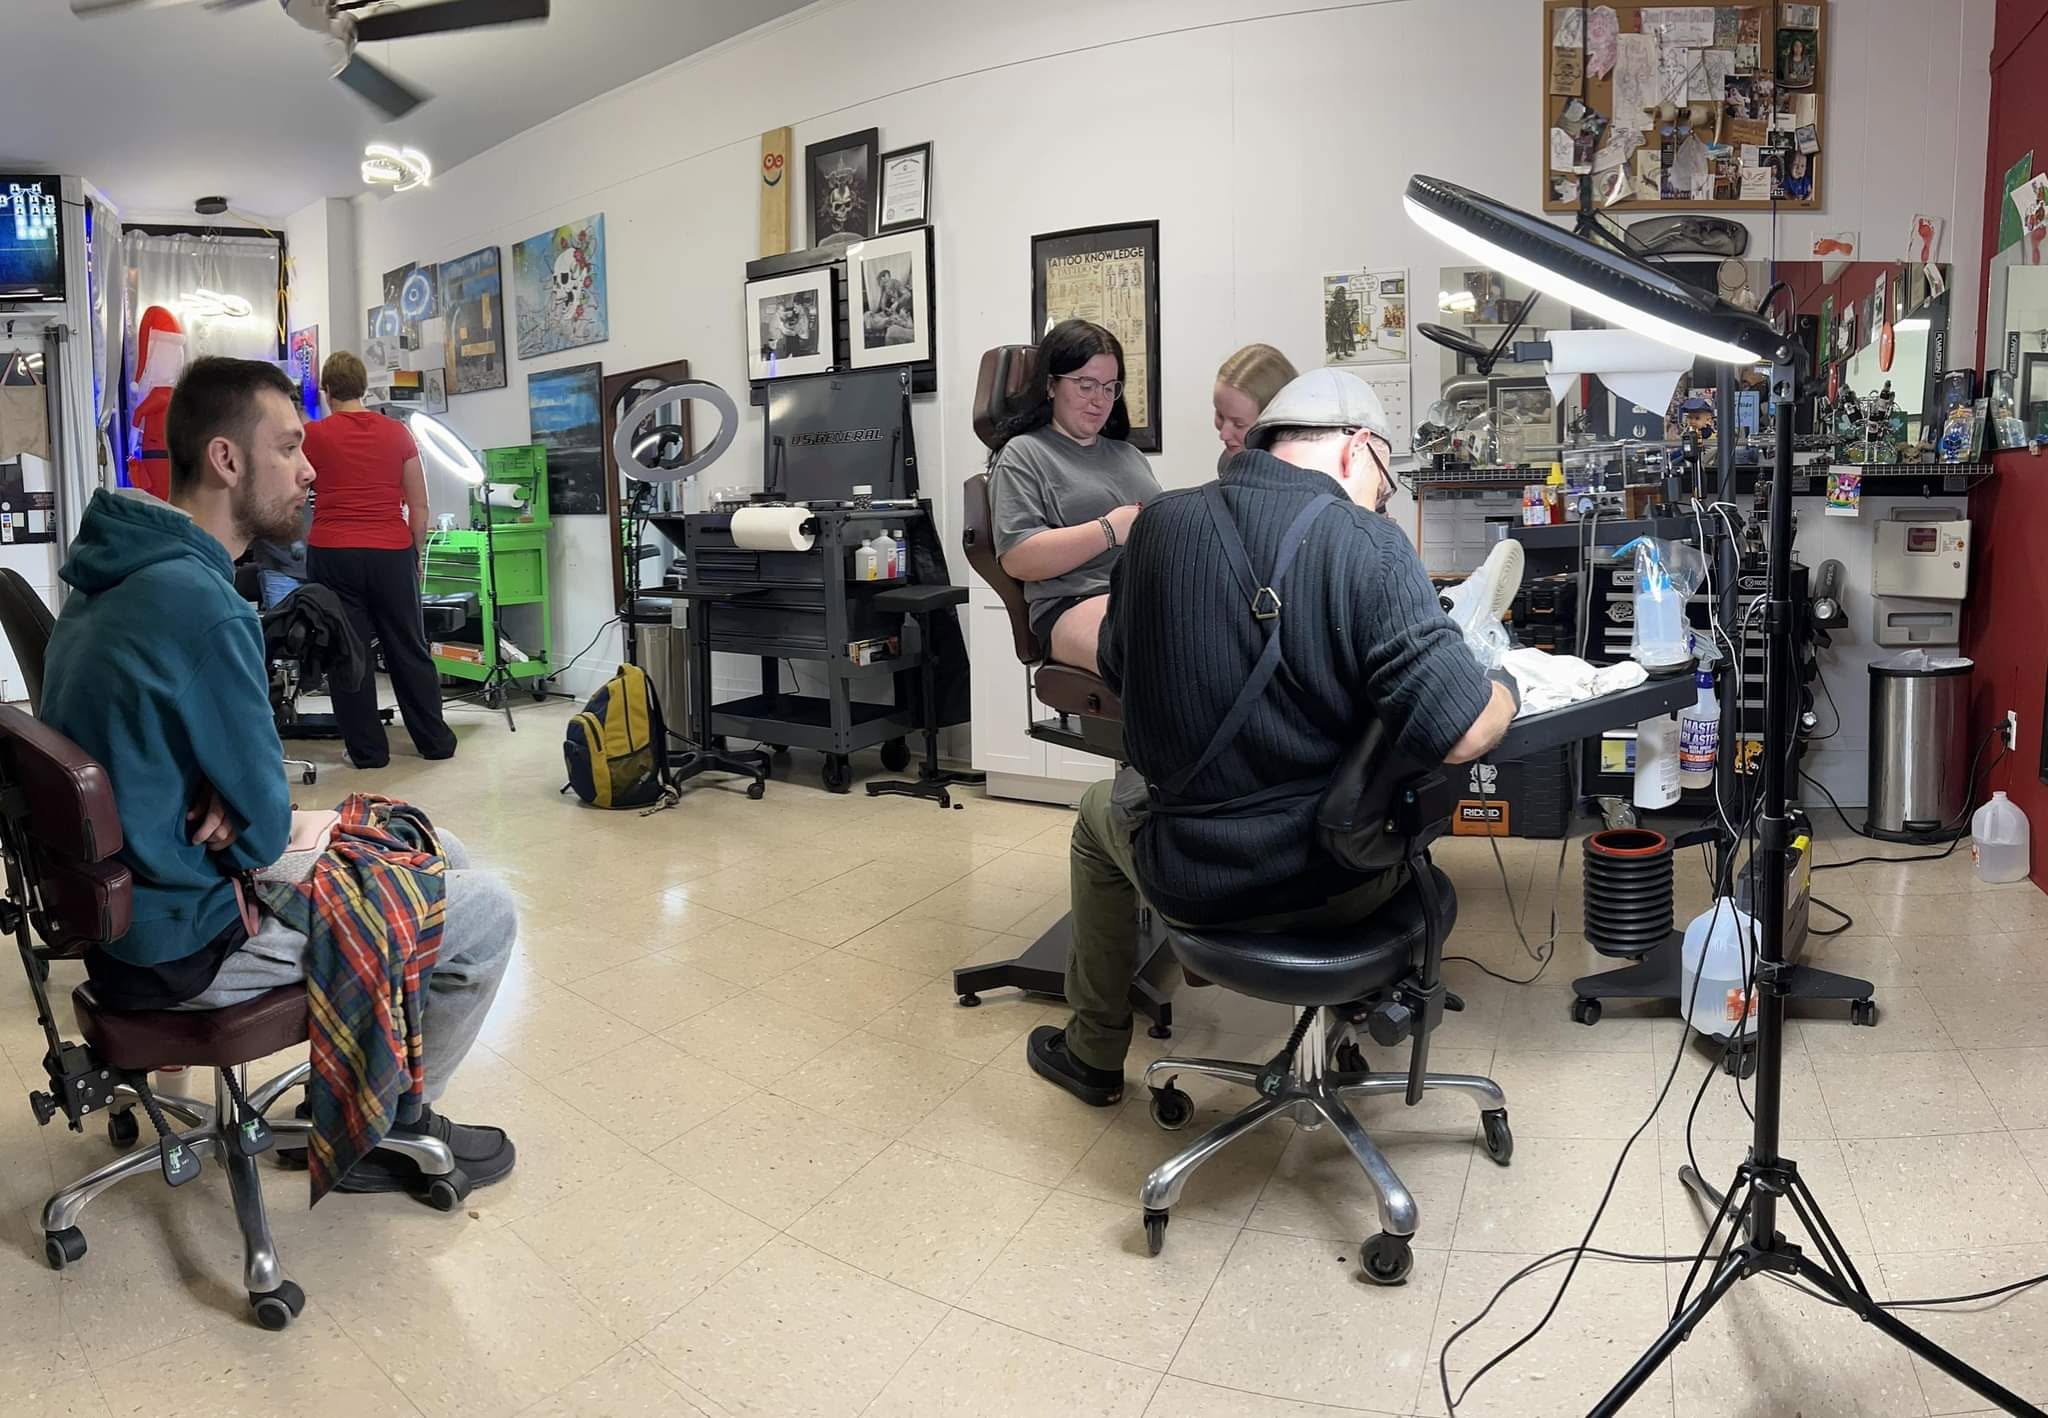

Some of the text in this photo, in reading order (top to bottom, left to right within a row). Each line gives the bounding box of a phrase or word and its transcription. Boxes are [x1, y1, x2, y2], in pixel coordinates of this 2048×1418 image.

[1048, 248, 1144, 268] TATTOO KNOWLEDGE
[1681, 731, 1719, 746] BLASTE
